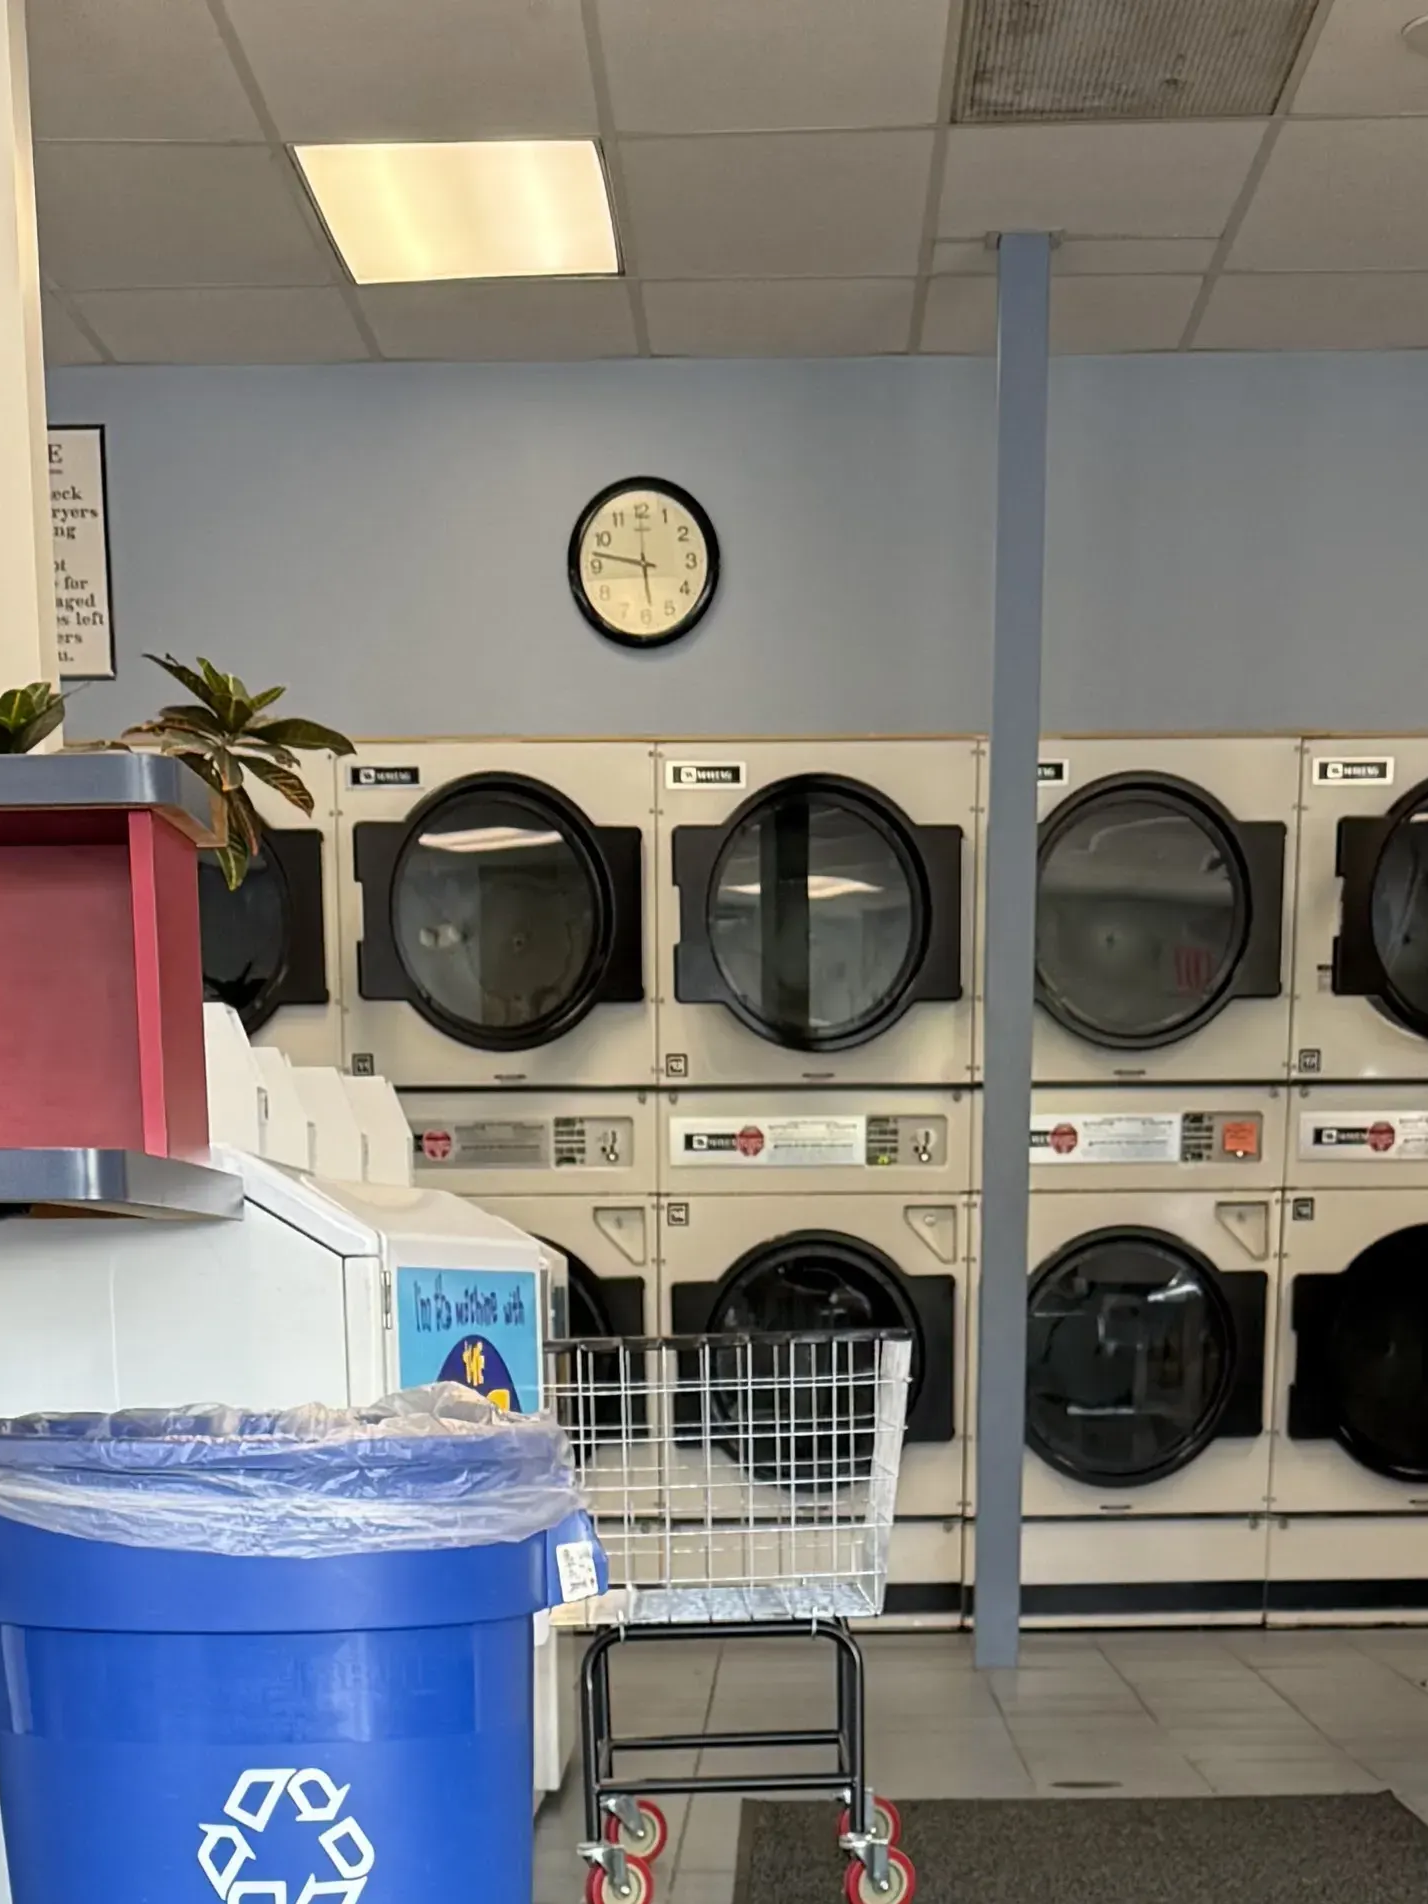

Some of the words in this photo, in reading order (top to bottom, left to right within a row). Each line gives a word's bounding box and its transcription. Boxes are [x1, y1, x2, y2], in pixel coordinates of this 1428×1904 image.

[633, 503, 651, 520] 12
[612, 512, 625, 528] 11
[594, 531, 612, 547] 10
[677, 526, 690, 542] 2
[590, 559, 603, 575] 9
[685, 552, 698, 570] 3
[64, 576, 88, 590] for
[679, 580, 691, 596] 4
[599, 585, 611, 601] 8
[619, 603, 630, 619] 7
[664, 600, 676, 617] 5
[76, 611, 105, 627] left
[640, 609, 652, 625] 6
